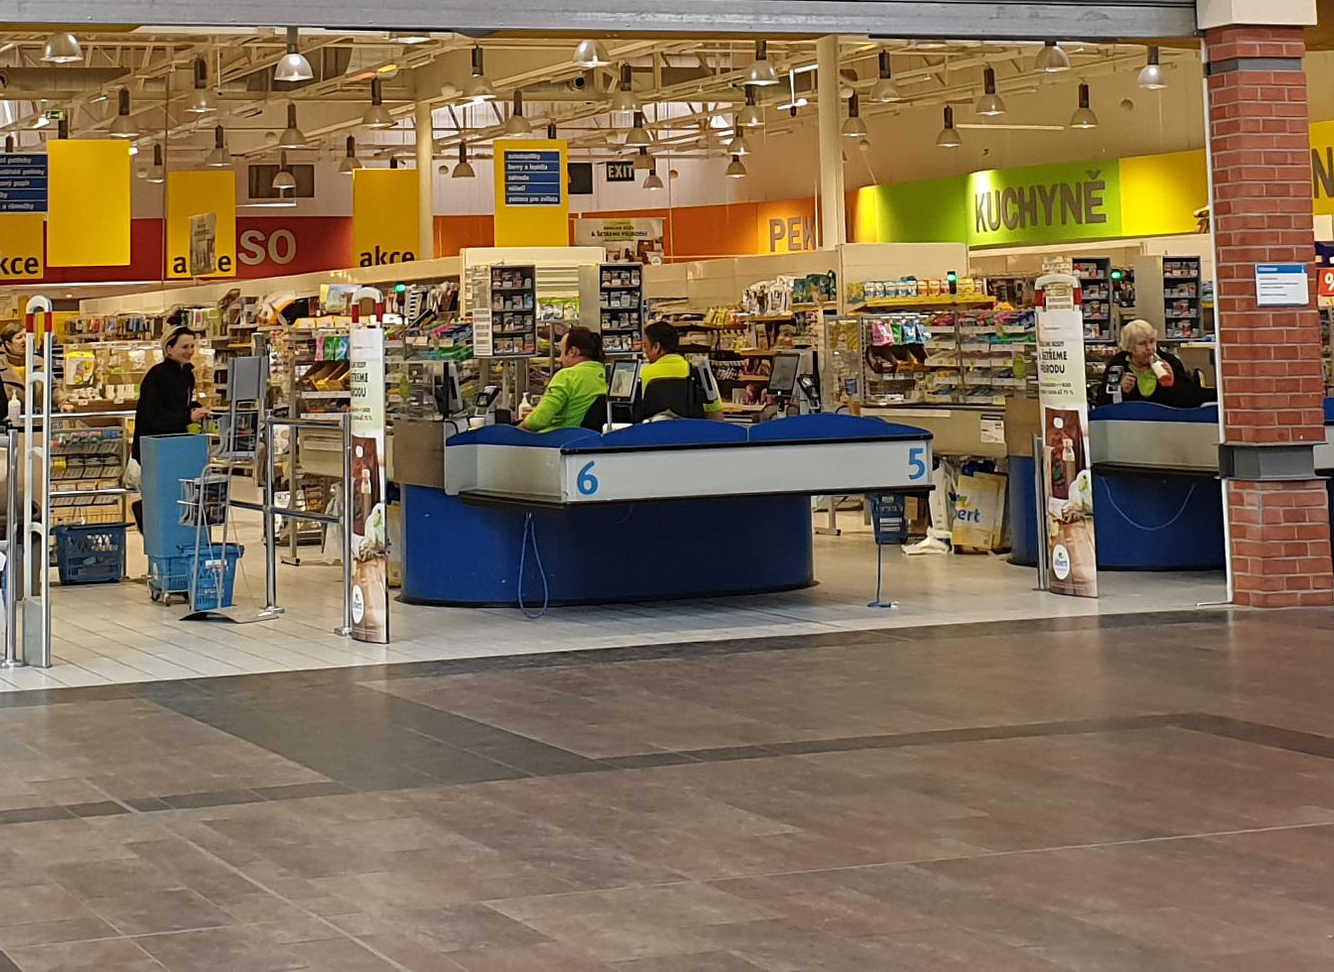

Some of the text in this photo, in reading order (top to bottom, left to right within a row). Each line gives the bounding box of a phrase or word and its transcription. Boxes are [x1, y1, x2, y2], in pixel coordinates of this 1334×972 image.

[608, 165, 634, 178] EXIT
[975, 170, 1107, 233] KUCHYNĚ
[238, 229, 297, 265] SO
[360, 246, 415, 267] akce
[173, 255, 231, 274] ae
[908, 447, 925, 480] 5
[576, 460, 599, 495] 6
[956, 508, 981, 523] ert
